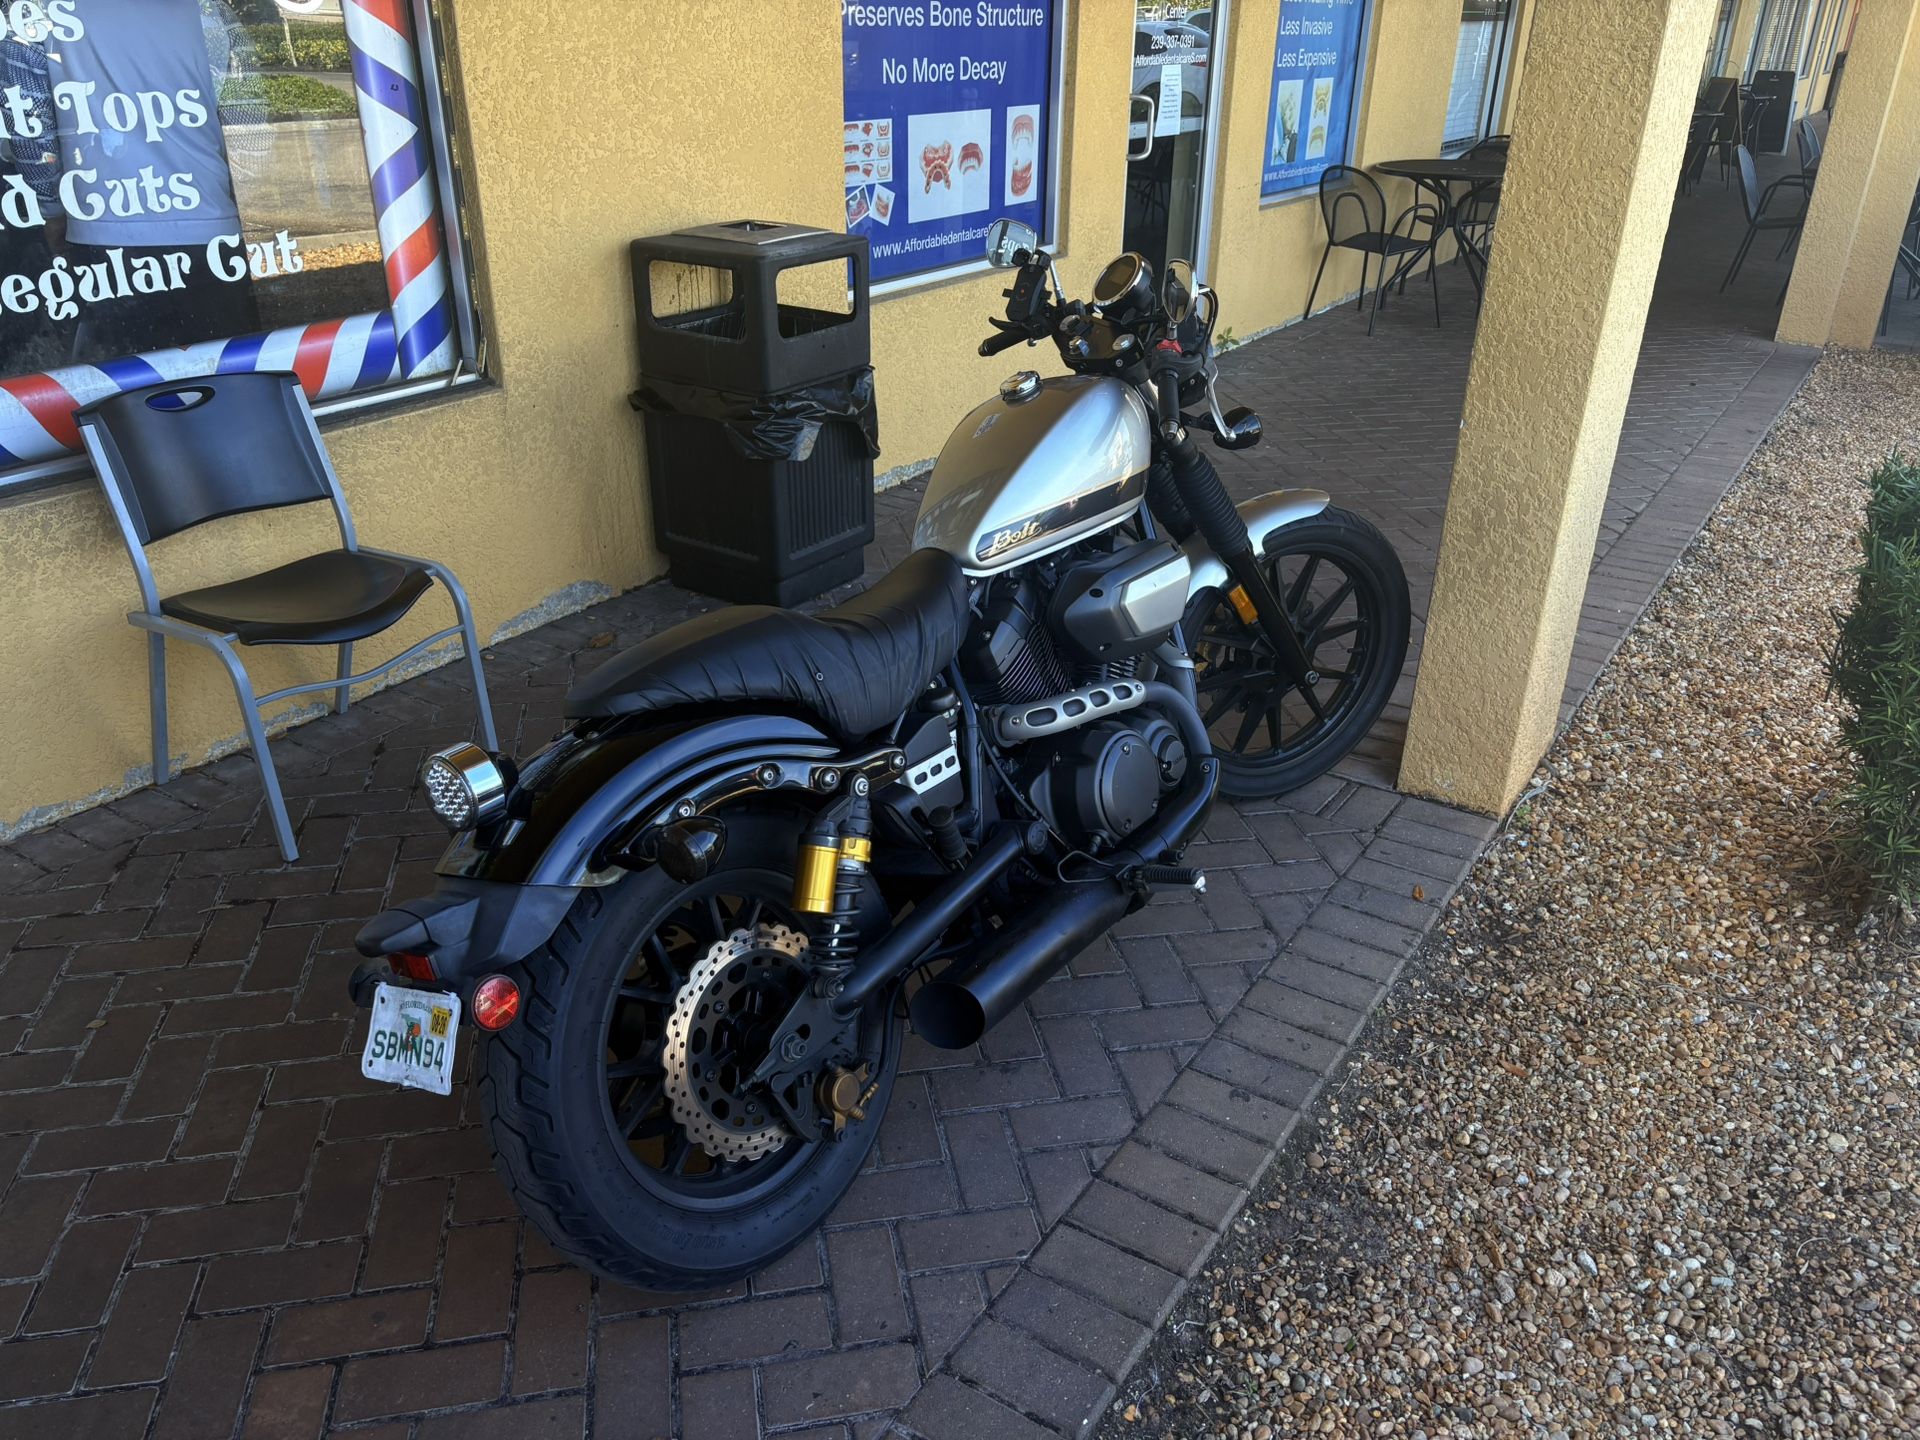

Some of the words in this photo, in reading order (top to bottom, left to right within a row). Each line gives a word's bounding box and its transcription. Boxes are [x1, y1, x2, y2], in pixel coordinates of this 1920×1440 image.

[0, 0, 84, 42] es
[930, 1, 972, 26] Bone
[976, 2, 1044, 26] Structure
[1281, 16, 1300, 35] Less
[1301, 16, 1333, 35] Invasive
[1151, 35, 1195, 49] 239-337-0391
[882, 58, 907, 84] No
[913, 57, 955, 83] More
[960, 56, 1007, 84] Decay
[1277, 48, 1297, 67] Less
[1297, 48, 1337, 71] Expensive
[0, 85, 42, 139] t
[54, 80, 208, 143] Tops
[0, 174, 46, 231] d
[59, 165, 201, 221] Cuts
[0, 247, 192, 321] egular
[206, 229, 304, 282] Cut
[987, 520, 1042, 553] Bolt
